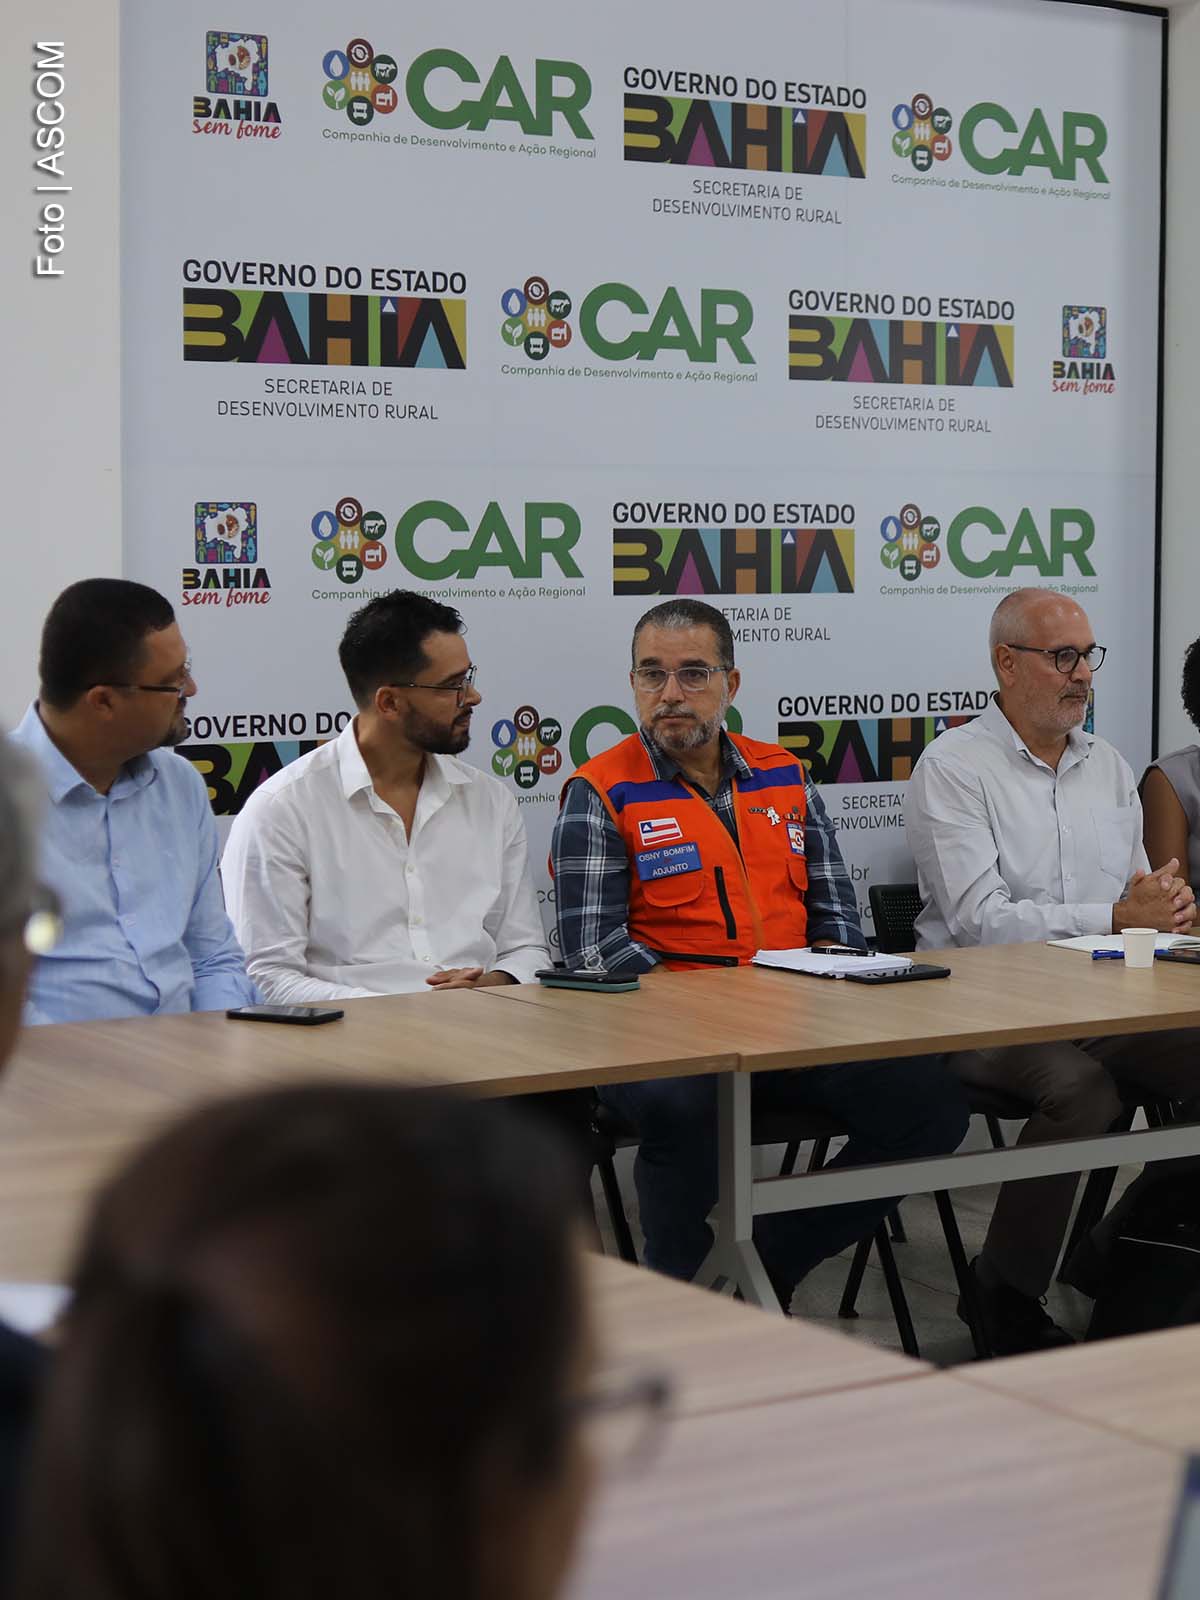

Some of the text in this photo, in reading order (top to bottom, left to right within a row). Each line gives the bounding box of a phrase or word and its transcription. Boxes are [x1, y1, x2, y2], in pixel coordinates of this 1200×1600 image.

[406, 48, 595, 140] CAR
[623, 66, 867, 109] GOVERNO DO ESTADO
[192, 97, 281, 123] BAHIA
[192, 118, 281, 139] sem fome
[623, 92, 867, 179] BAHIA
[322, 128, 597, 160] Companhia de Desenvolvimento e Ação Regional
[958, 102, 1110, 184] CAR
[692, 179, 803, 201] SECRETARIA DE
[891, 174, 946, 188] Companhia
[948, 178, 960, 189] de
[962, 179, 1040, 195] Desenvolvimento
[1048, 187, 1071, 199] Ação
[1073, 188, 1111, 201] Regional
[651, 198, 842, 224] DESENVOLVIMENTO RURAL
[182, 258, 467, 295] GOVERNO DO ESTADO
[788, 289, 1016, 321] GOVERNO DO ESTADO
[183, 287, 467, 370] BAHIA
[579, 282, 757, 365] CAR
[788, 314, 1015, 388] BAHIA
[500, 363, 566, 378] Companhia
[567, 366, 582, 377] de
[583, 367, 674, 381] Desenvolvimento
[684, 370, 712, 383] Ação
[713, 371, 758, 384] Regional
[1052, 360, 1115, 381] BAHIA
[264, 377, 393, 398] SECRETARIA DE
[1051, 379, 1115, 397] sem fome
[216, 400, 439, 421] DESENVOLVIMENTO RURAL
[852, 395, 956, 413] SECRETARIA DE
[815, 415, 992, 434] DESENVOLVIMENTO RURAL
[612, 502, 856, 524] GOVERNO DO ESTADO
[395, 500, 585, 581] CAR
[946, 506, 1097, 579] CAR
[613, 529, 855, 596] BAHIA
[182, 568, 271, 590] BAHIA
[879, 585, 935, 595] Companhia
[937, 585, 949, 594] de
[1060, 584, 1099, 595] Regional
[181, 586, 272, 609] sem fome
[311, 588, 379, 600] Companhia
[499, 588, 505, 597] e
[508, 587, 536, 600] Ação
[539, 586, 586, 599] Regional
[774, 607, 791, 621] DE
[785, 627, 831, 641] RURAL
[777, 693, 884, 717] GOVERNO
[891, 692, 920, 713] DO
[316, 711, 352, 734] DO
[639, 851, 661, 863] OSNY
[663, 845, 695, 858] BOMFIM
[652, 862, 688, 877] ADJUNTO
